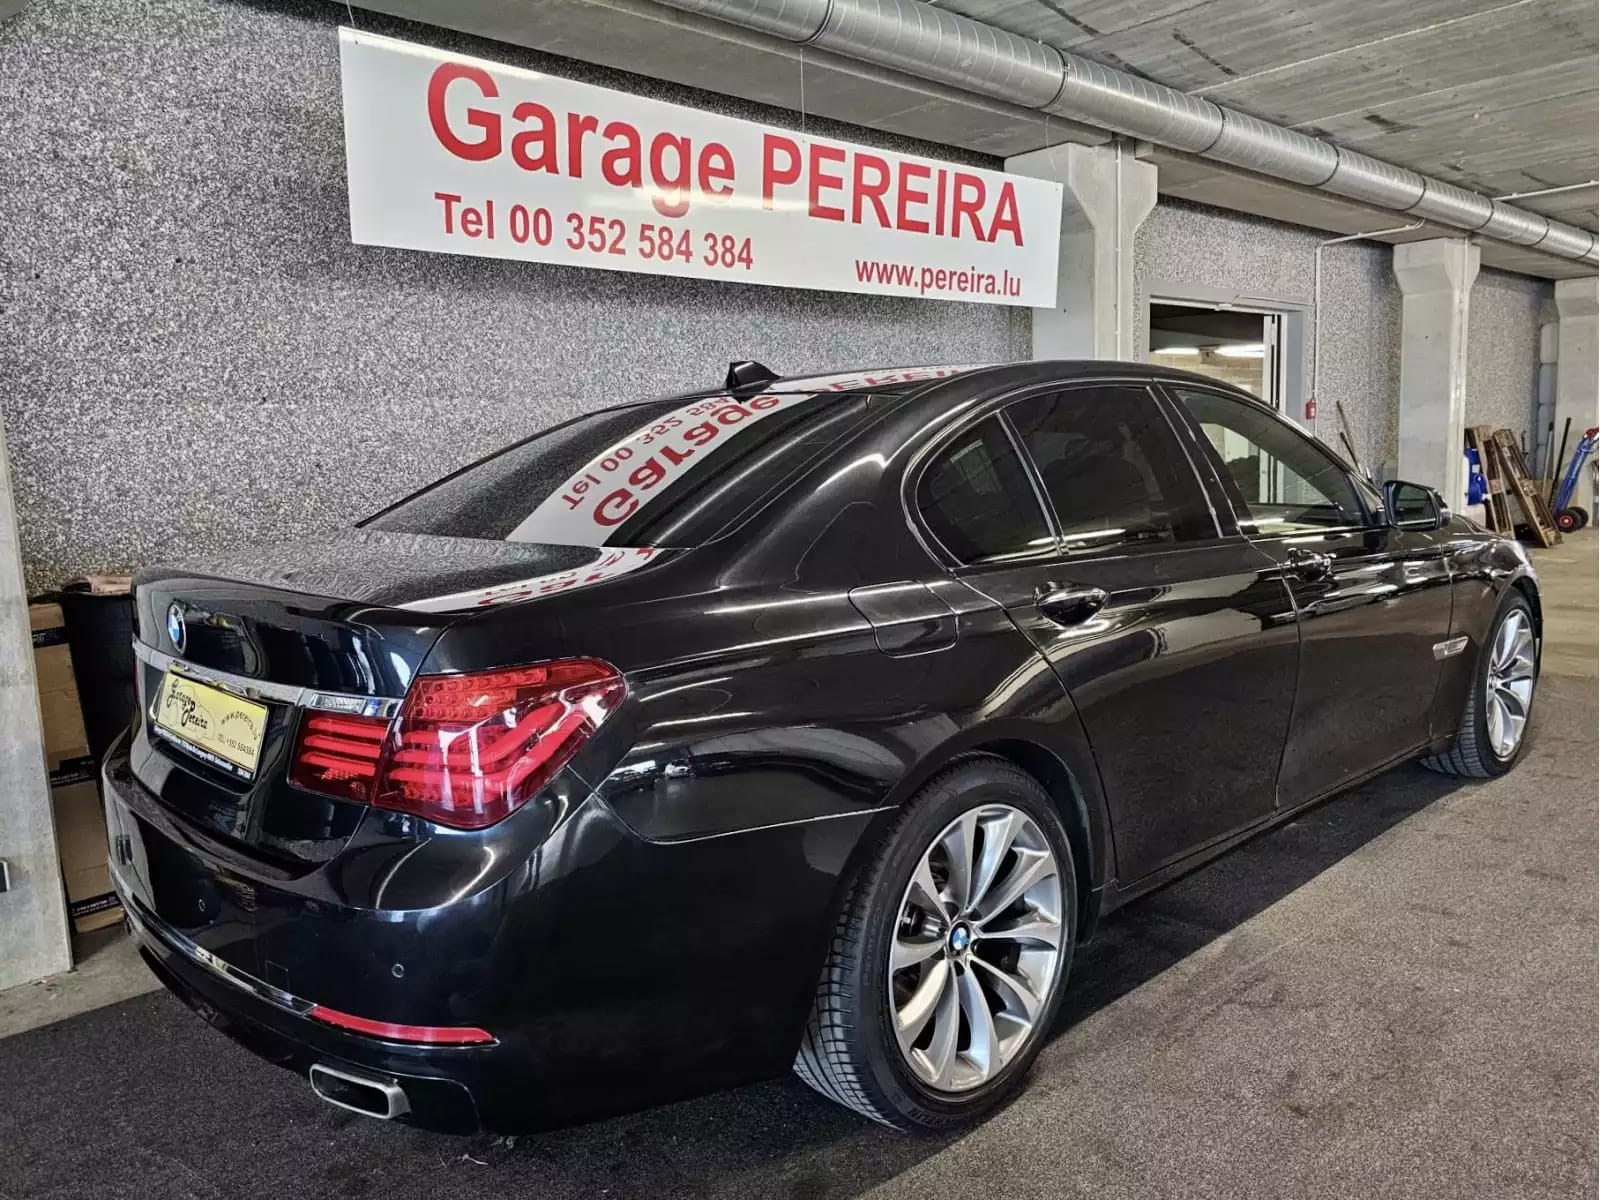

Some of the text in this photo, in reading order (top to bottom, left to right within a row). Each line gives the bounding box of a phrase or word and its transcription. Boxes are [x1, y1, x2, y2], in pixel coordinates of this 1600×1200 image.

[427, 61, 1024, 248] Garage PEREIRA
[434, 192, 754, 270] Tel 00 352 584 384
[855, 259, 1021, 297] www.pereira.lu
